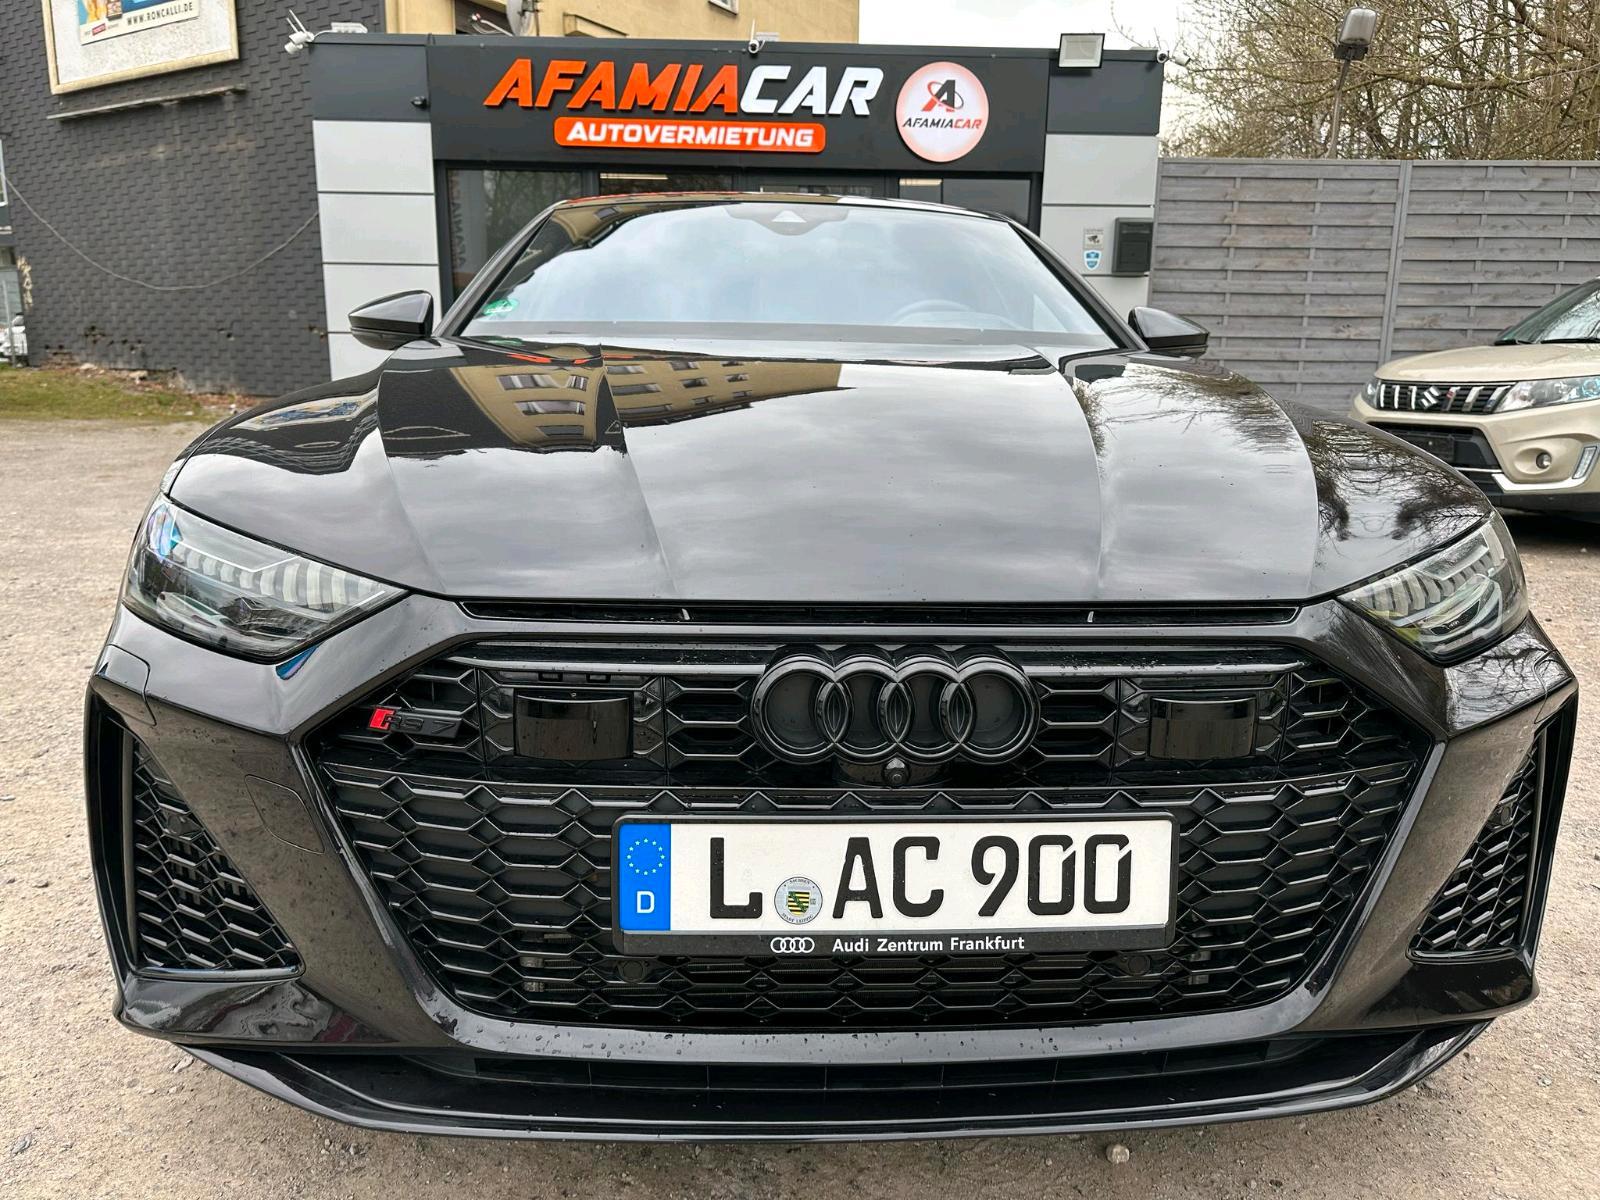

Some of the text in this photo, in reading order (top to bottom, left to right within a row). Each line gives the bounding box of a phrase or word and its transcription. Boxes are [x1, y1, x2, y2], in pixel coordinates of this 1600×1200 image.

[127, 2, 193, 25] WWW.RONCALLI.DE
[483, 58, 884, 116] AFAMIACAR
[566, 121, 815, 147] AUTOVERMIETUNG
[902, 117, 982, 129] AFAMIACAR
[709, 833, 1133, 920] L AC 900
[636, 891, 655, 914] D
[832, 936, 1025, 952] Audi Zentrum Frankfurt
